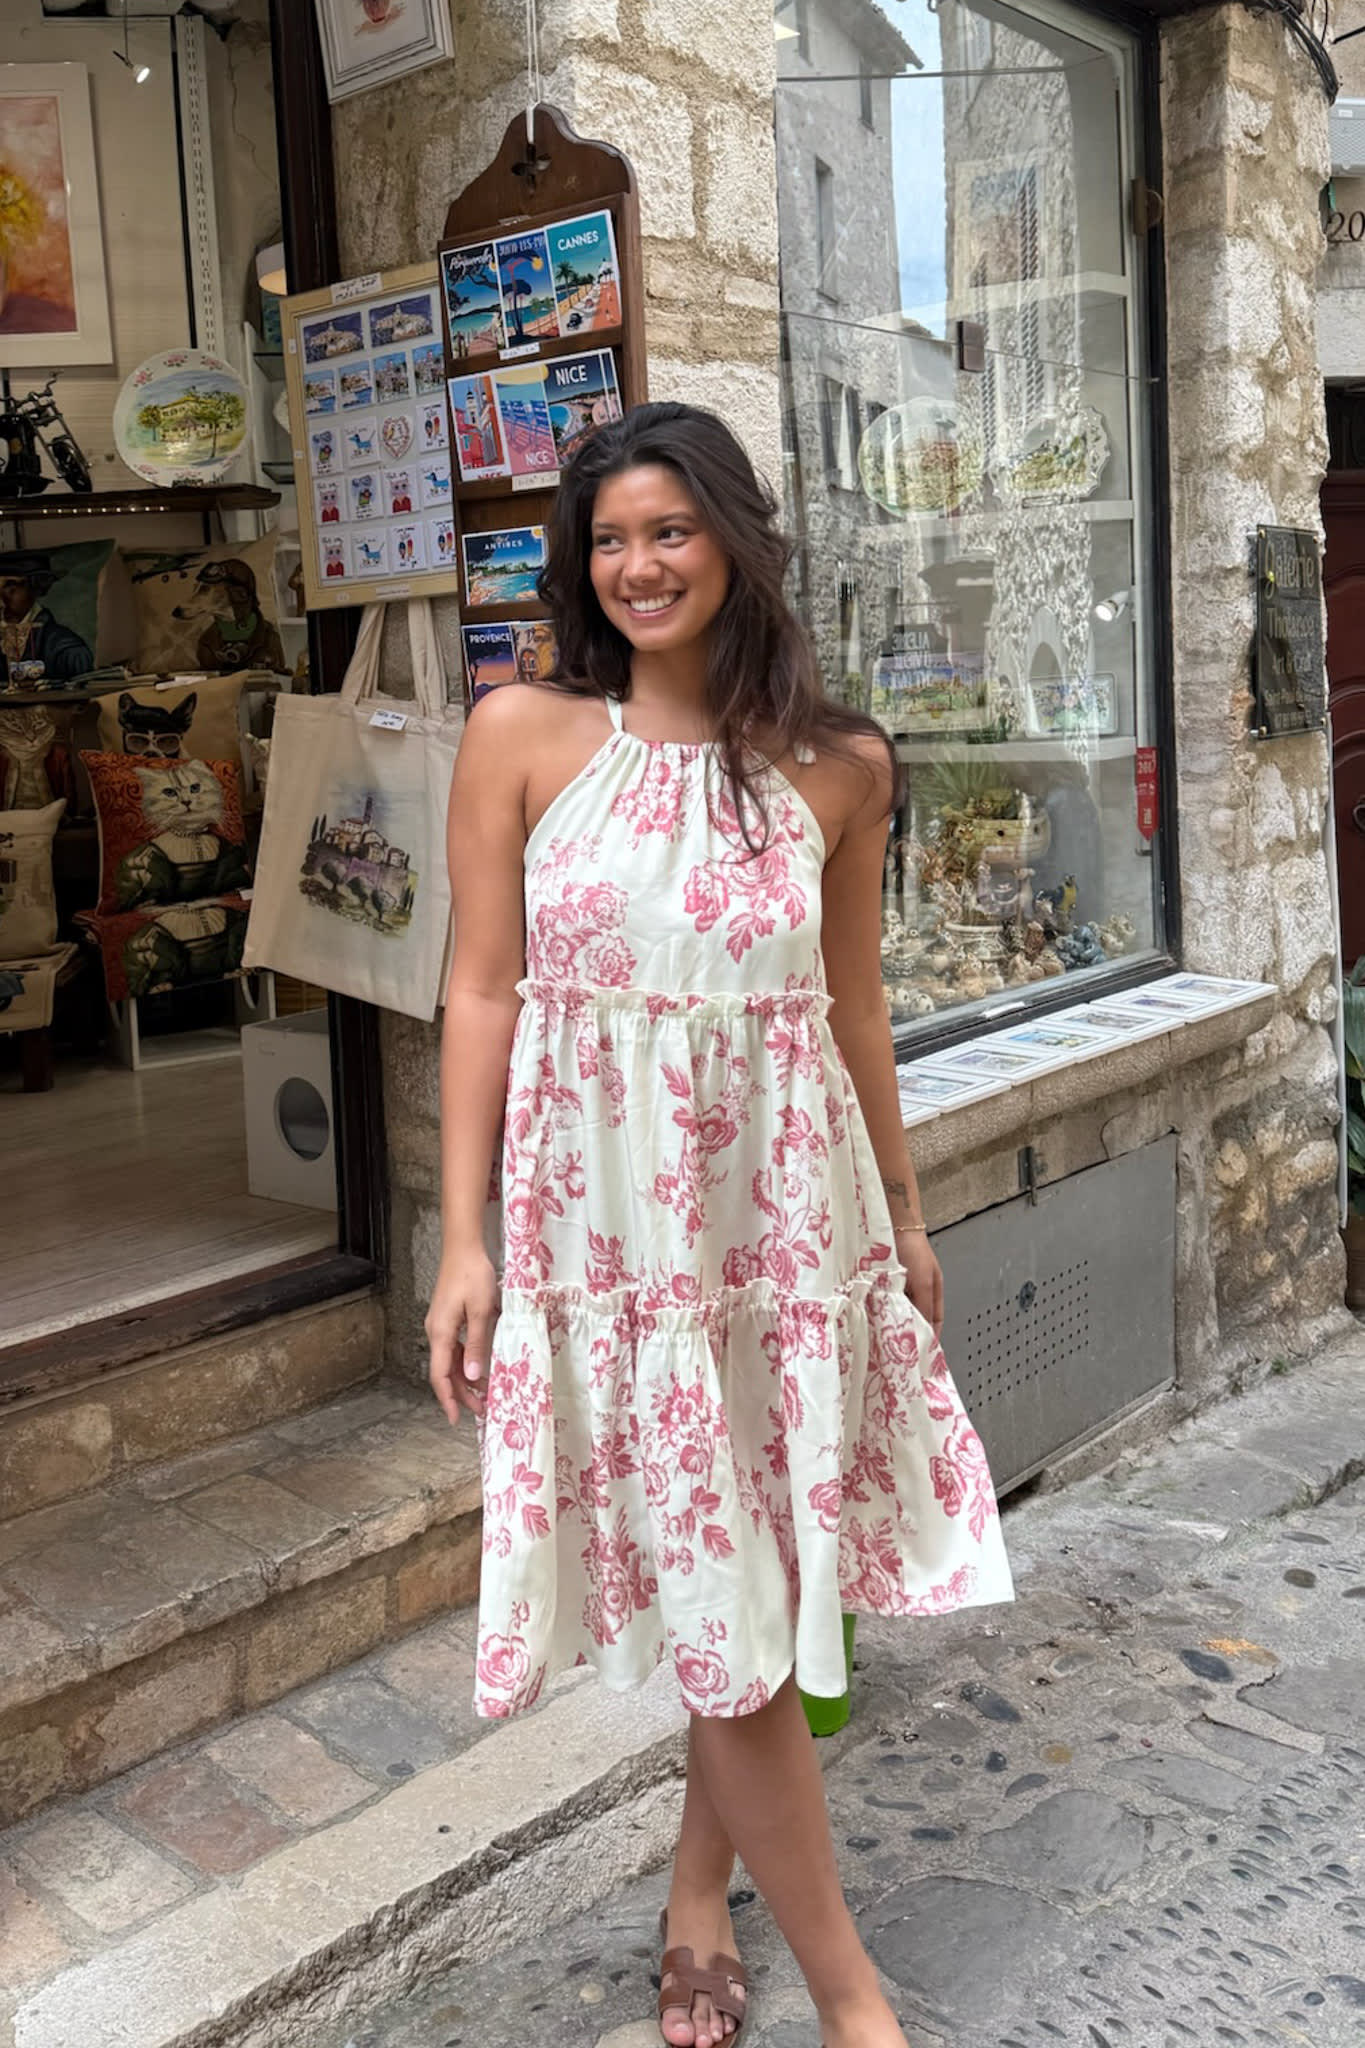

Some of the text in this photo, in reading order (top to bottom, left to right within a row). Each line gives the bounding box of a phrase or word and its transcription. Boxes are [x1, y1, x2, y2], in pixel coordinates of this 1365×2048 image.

[1328, 211, 1365, 243] 20
[557, 230, 600, 251] CANNES
[555, 364, 588, 387] NICE
[525, 450, 551, 467] NICE
[485, 539, 523, 550] ANTIBES
[469, 634, 513, 644] PROVENCE
